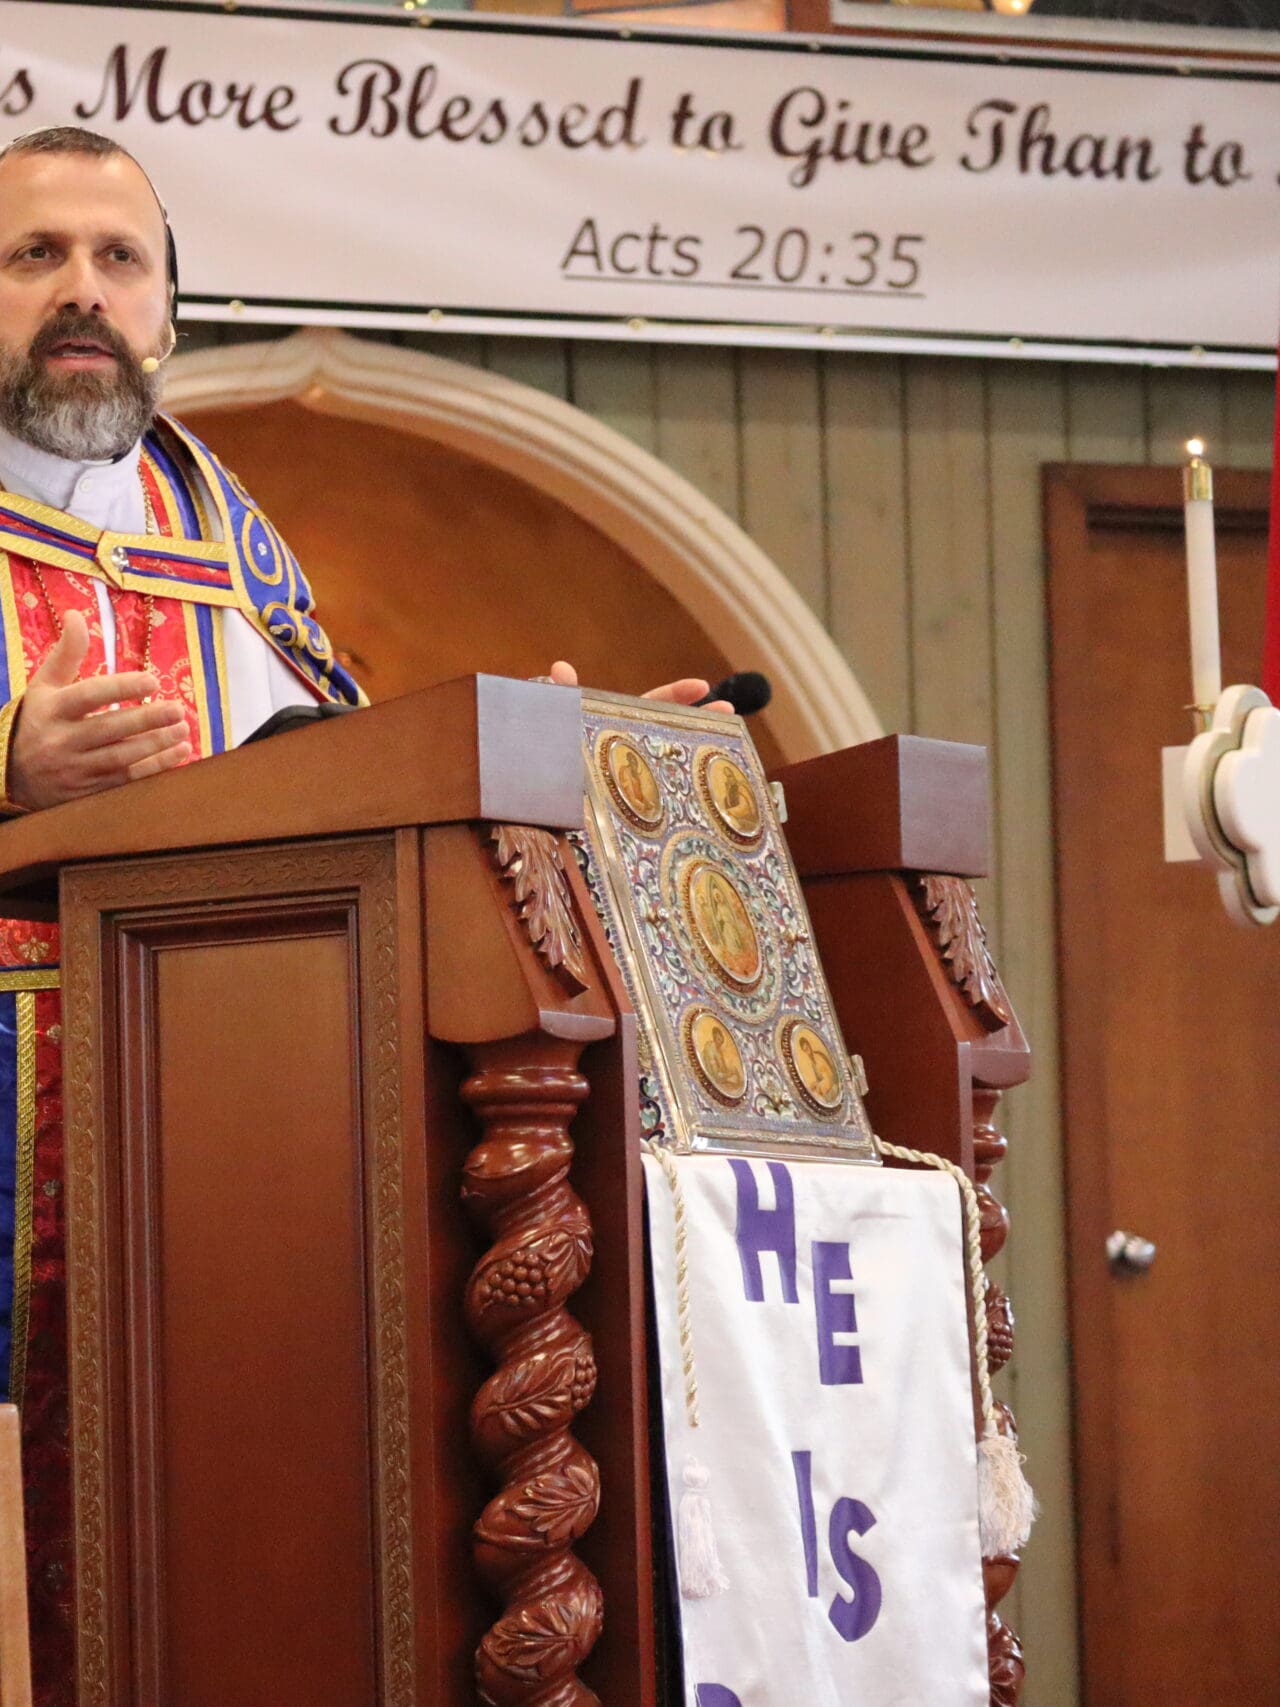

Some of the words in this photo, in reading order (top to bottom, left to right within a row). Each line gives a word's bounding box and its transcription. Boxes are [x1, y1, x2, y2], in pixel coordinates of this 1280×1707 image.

[75, 43, 300, 132] More
[328, 58, 645, 149] Blessed
[671, 91, 744, 153] to
[767, 86, 935, 189] Give
[960, 98, 1160, 184] Than
[1183, 121, 1253, 188] to
[561, 217, 701, 277] Acts
[730, 225, 925, 290] 20:35
[727, 1158, 864, 1386] HE
[791, 1450, 882, 1642] IS
